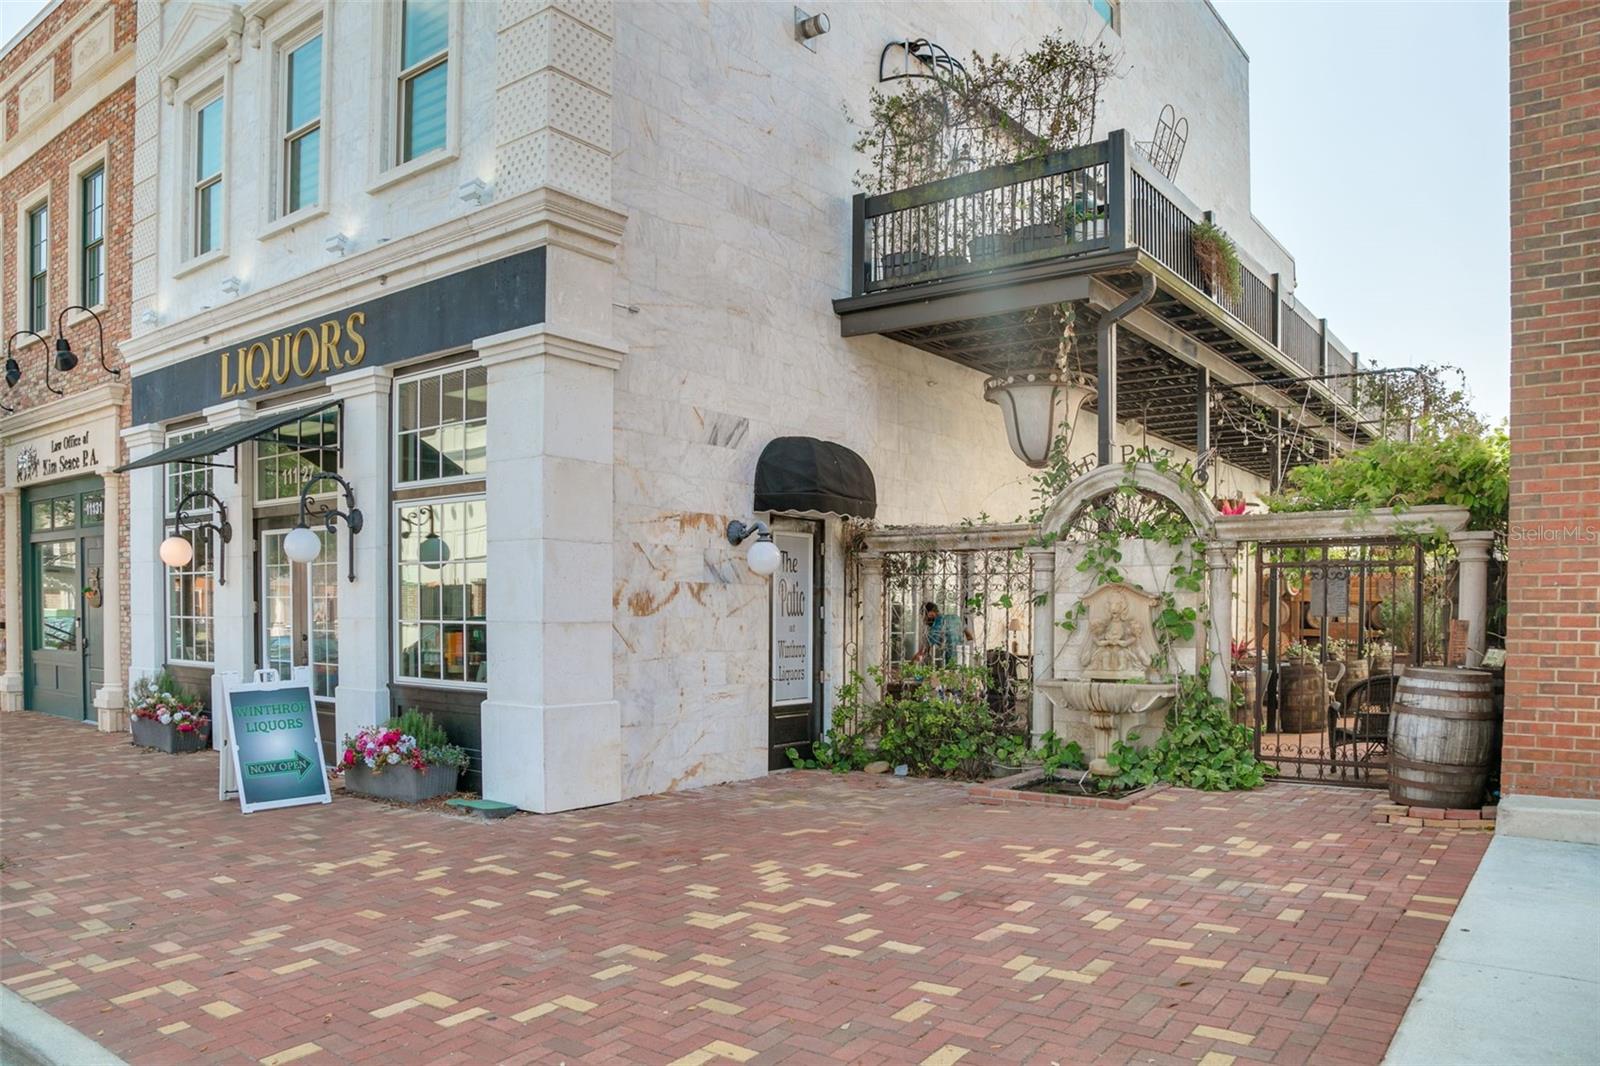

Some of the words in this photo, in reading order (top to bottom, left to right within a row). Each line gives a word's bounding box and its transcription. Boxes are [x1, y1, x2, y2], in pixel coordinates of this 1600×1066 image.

[221, 312, 366, 398] LIQUORS
[51, 439, 62, 453] Law
[63, 434, 81, 449] Office
[82, 431, 89, 445] of
[42, 459, 57, 475] Kim
[282, 465, 314, 485] 11127
[780, 550, 798, 573] The
[778, 579, 805, 617] Patio
[246, 718, 304, 733] LIQUORS
[250, 763, 277, 774] NOW
[279, 759, 307, 771] OPEN
